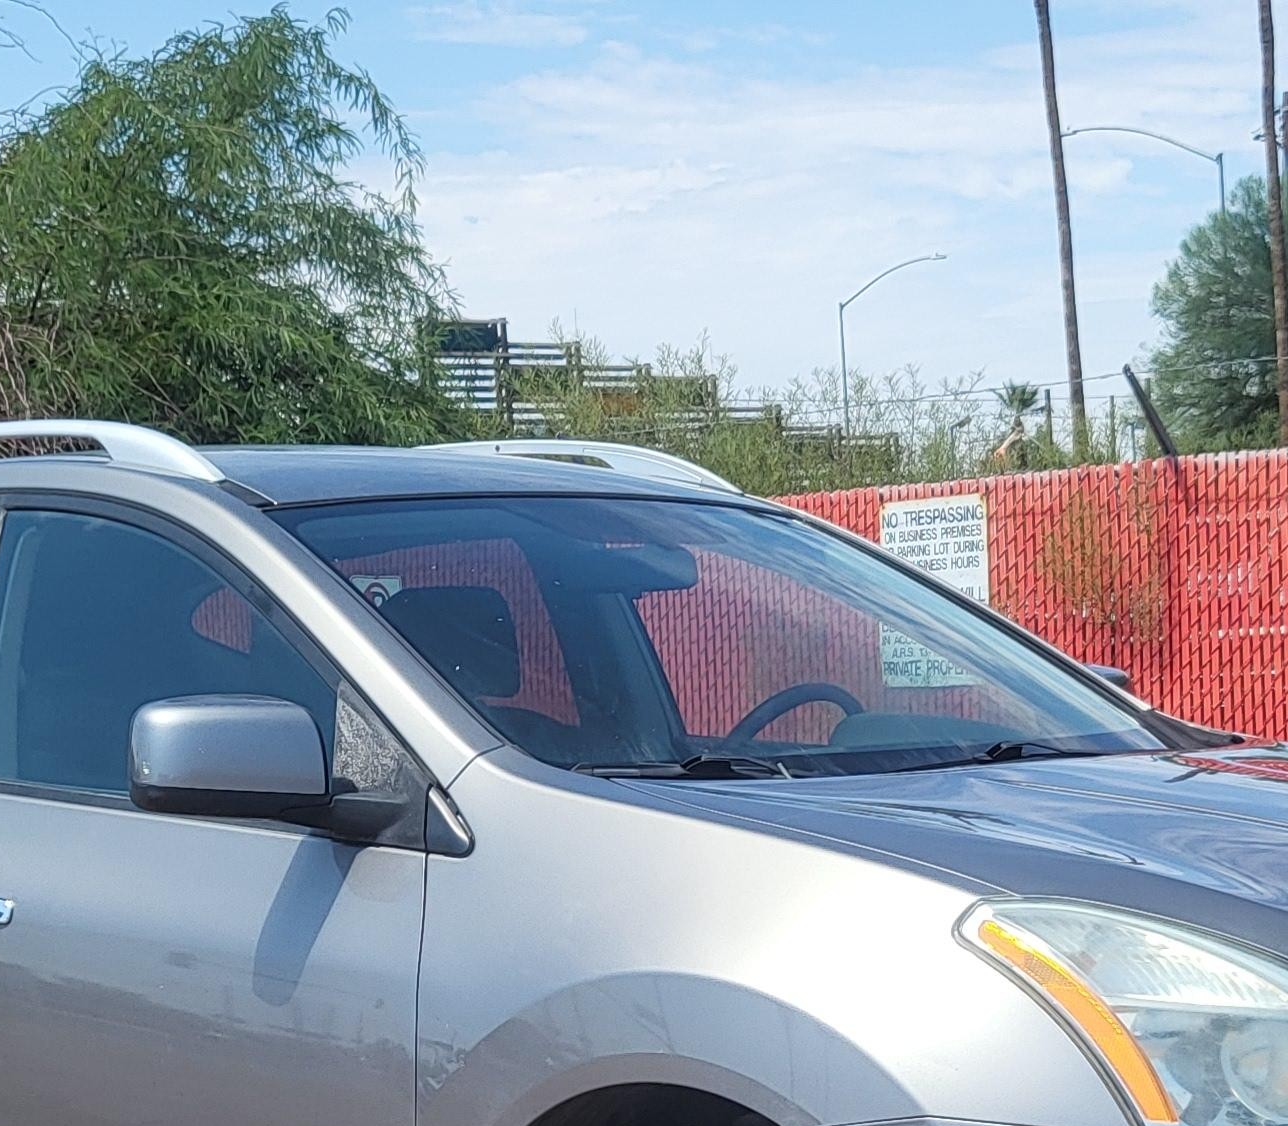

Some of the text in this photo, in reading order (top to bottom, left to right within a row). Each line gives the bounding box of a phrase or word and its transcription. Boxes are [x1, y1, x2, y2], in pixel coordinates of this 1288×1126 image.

[882, 504, 984, 529] NO TRESPASSING
[884, 524, 982, 545] ON BUSINESS PREMISES
[897, 543, 930, 558] PARKING
[934, 542, 950, 555] LOT
[954, 539, 984, 554] DURING
[951, 555, 980, 570] HOURS
[883, 660, 922, 677] PRIVATE
